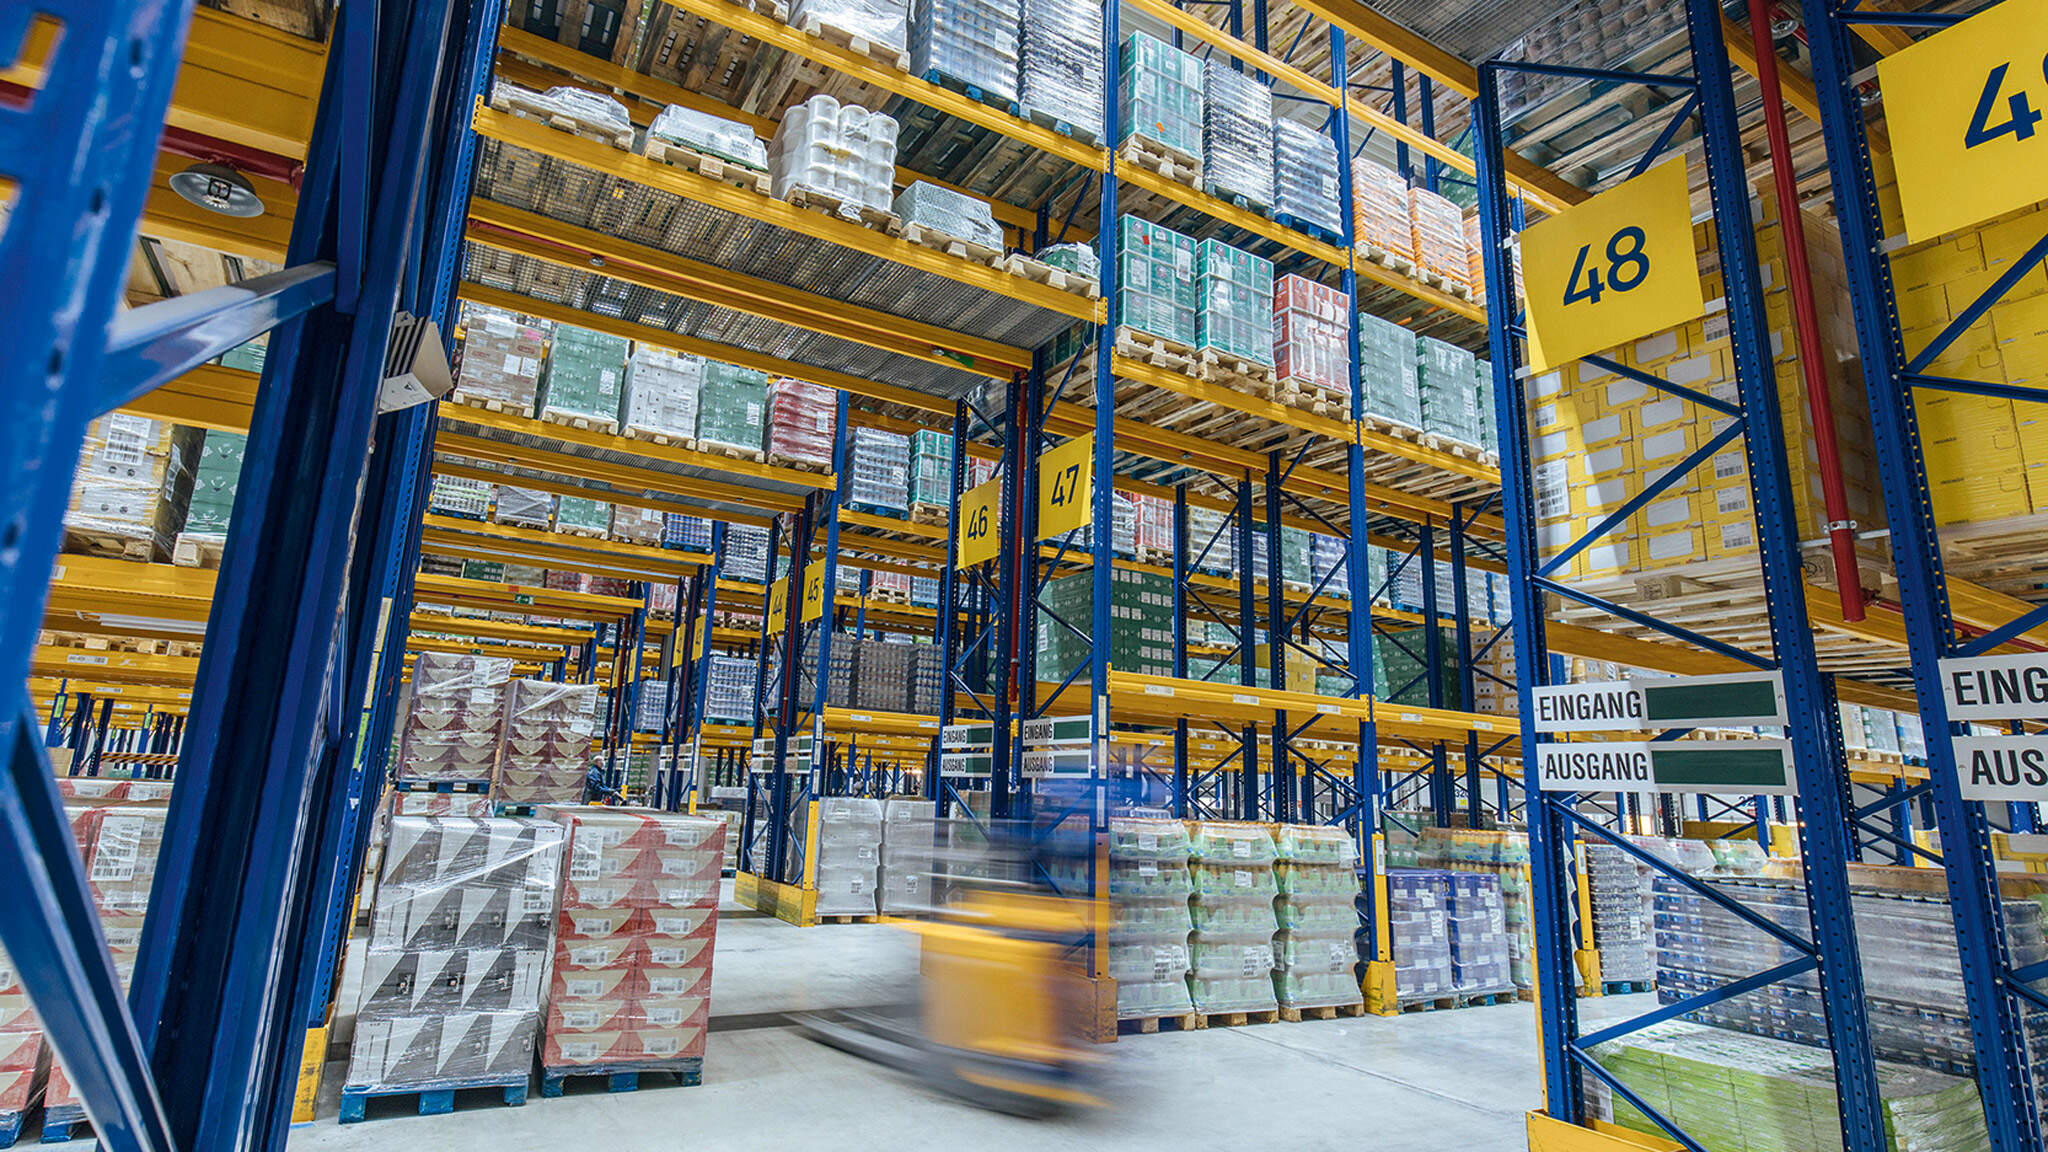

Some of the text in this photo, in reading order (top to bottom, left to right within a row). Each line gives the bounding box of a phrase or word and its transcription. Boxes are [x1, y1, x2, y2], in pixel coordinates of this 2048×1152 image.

[1964, 50, 2048, 149] 4
[1563, 226, 1651, 306] 48
[1051, 464, 1080, 506] 47
[967, 505, 988, 540] 46
[808, 577, 819, 603] 45
[1539, 690, 1642, 721] EINGANG
[943, 730, 966, 744] EINGANG
[1024, 723, 1052, 740] EINGANG
[943, 758, 965, 772] AUSGANG
[1024, 756, 1052, 772] AUSGANG
[1545, 752, 1648, 781] AUSGANG
